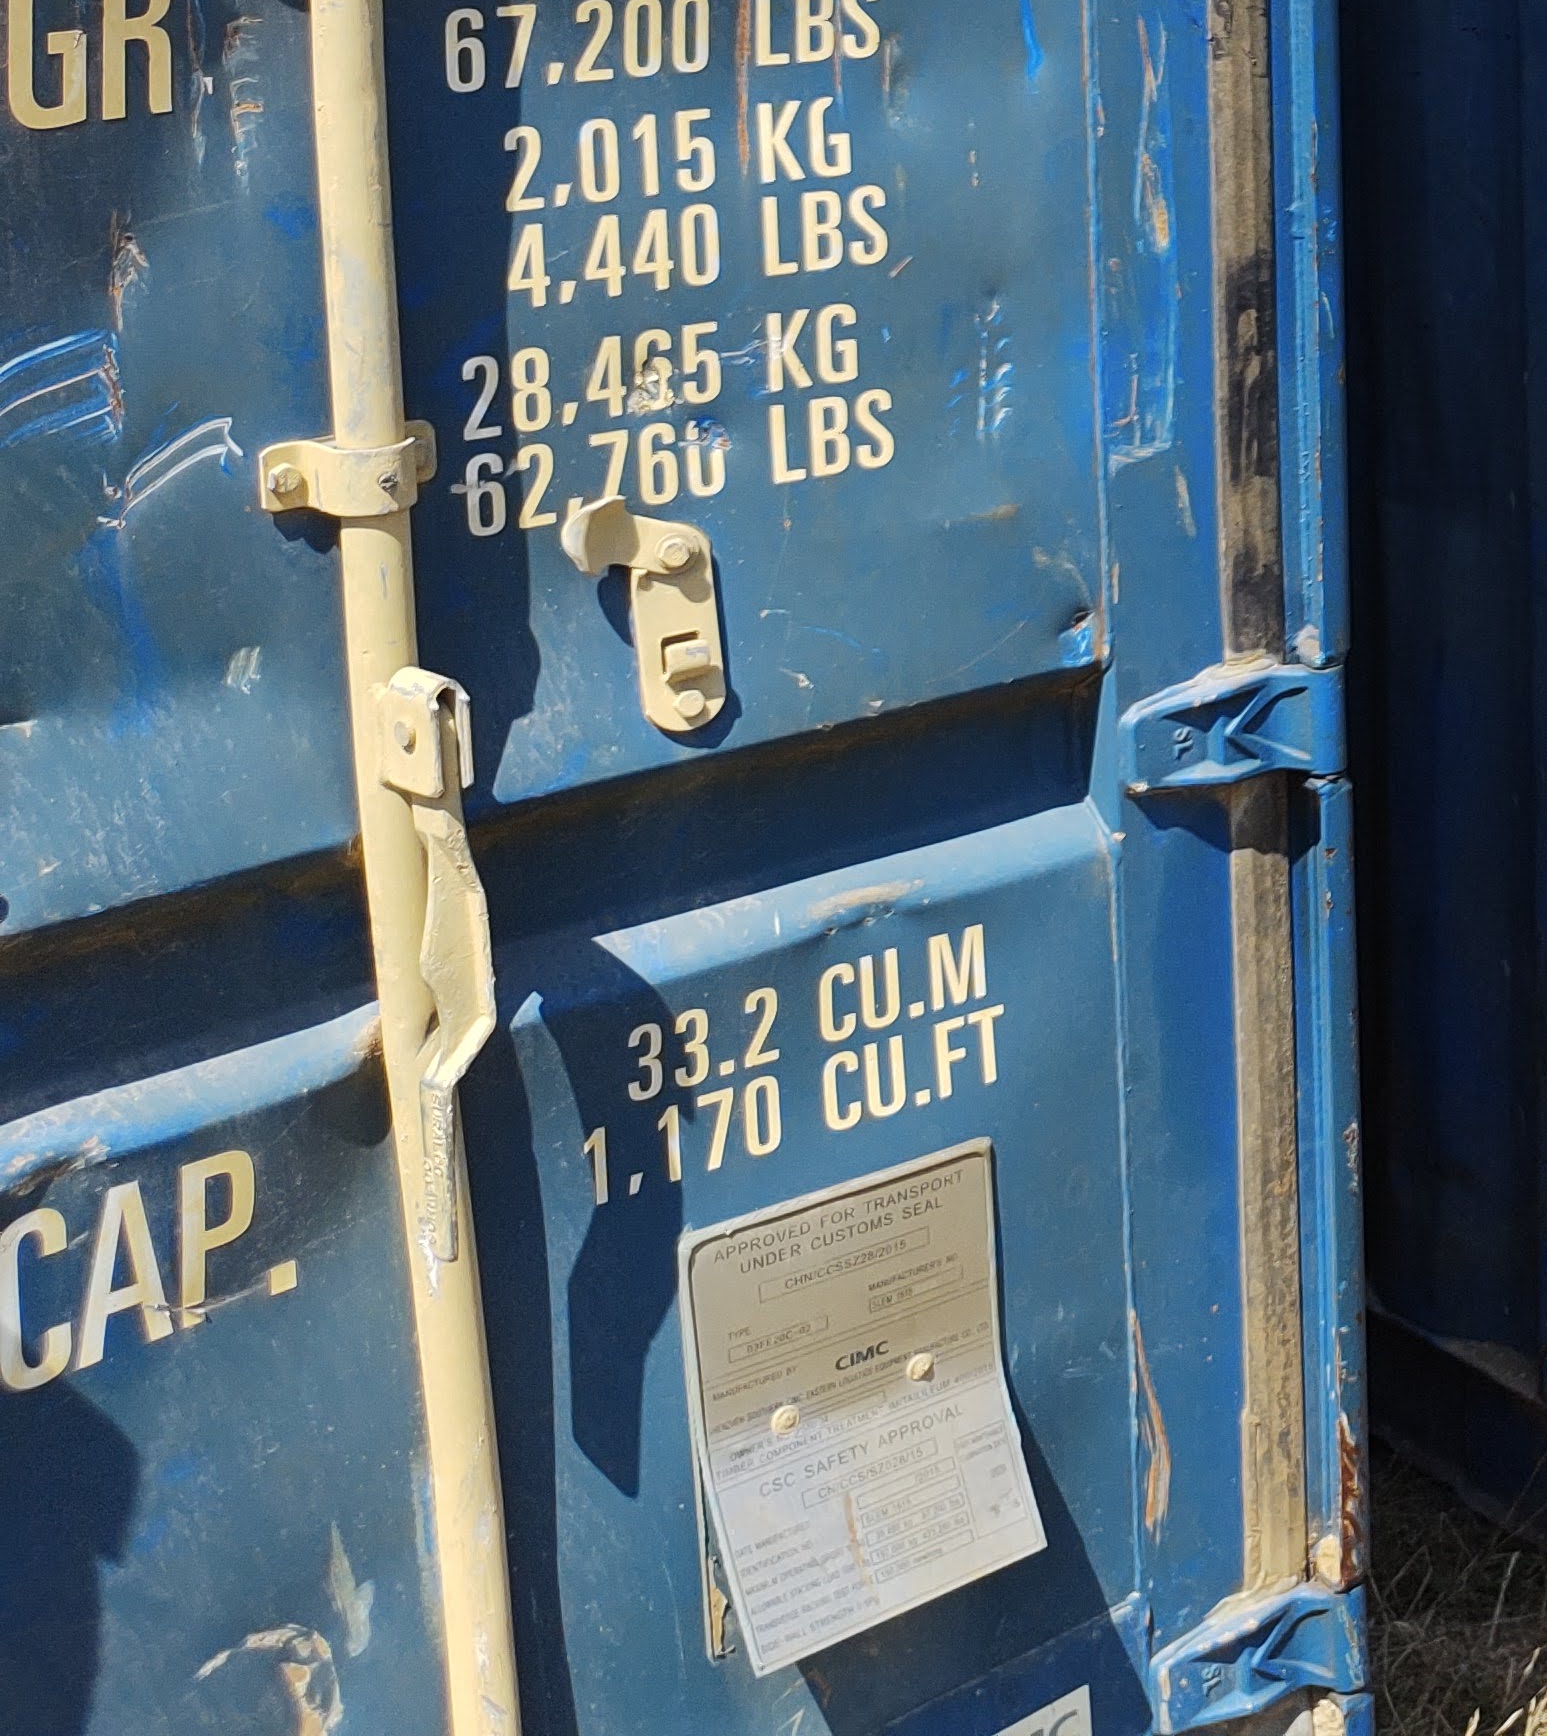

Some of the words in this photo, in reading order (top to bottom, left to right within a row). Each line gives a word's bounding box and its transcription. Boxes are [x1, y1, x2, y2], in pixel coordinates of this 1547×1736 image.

[503, 107, 717, 213] 2,015
[757, 95, 853, 184] KG
[507, 202, 721, 308] 4,440
[760, 183, 889, 278] LBS
[461, 319, 723, 442] 28,465
[766, 302, 860, 394] KG
[465, 421, 728, 537] 62,760
[767, 388, 896, 485] LBS
[626, 987, 781, 1104] 33.2
[818, 923, 989, 1045] CU.M
[581, 1074, 783, 1208] 1,170
[823, 1002, 1006, 1134] CU.FT
[0, 1150, 299, 1393] CAP.
[713, 1221, 811, 1264] APPROVED
[820, 1207, 855, 1230] FOR
[866, 1169, 966, 1213] TRANSPORT
[740, 1244, 801, 1274] UNDER
[810, 1215, 894, 1251] CUSTOMS
[902, 1197, 943, 1220] SEAL
[834, 1340, 890, 1371] CIMC
[758, 1471, 796, 1498] CSC
[803, 1439, 871, 1482] SAFETY
[877, 1404, 964, 1449] APPROVAL
